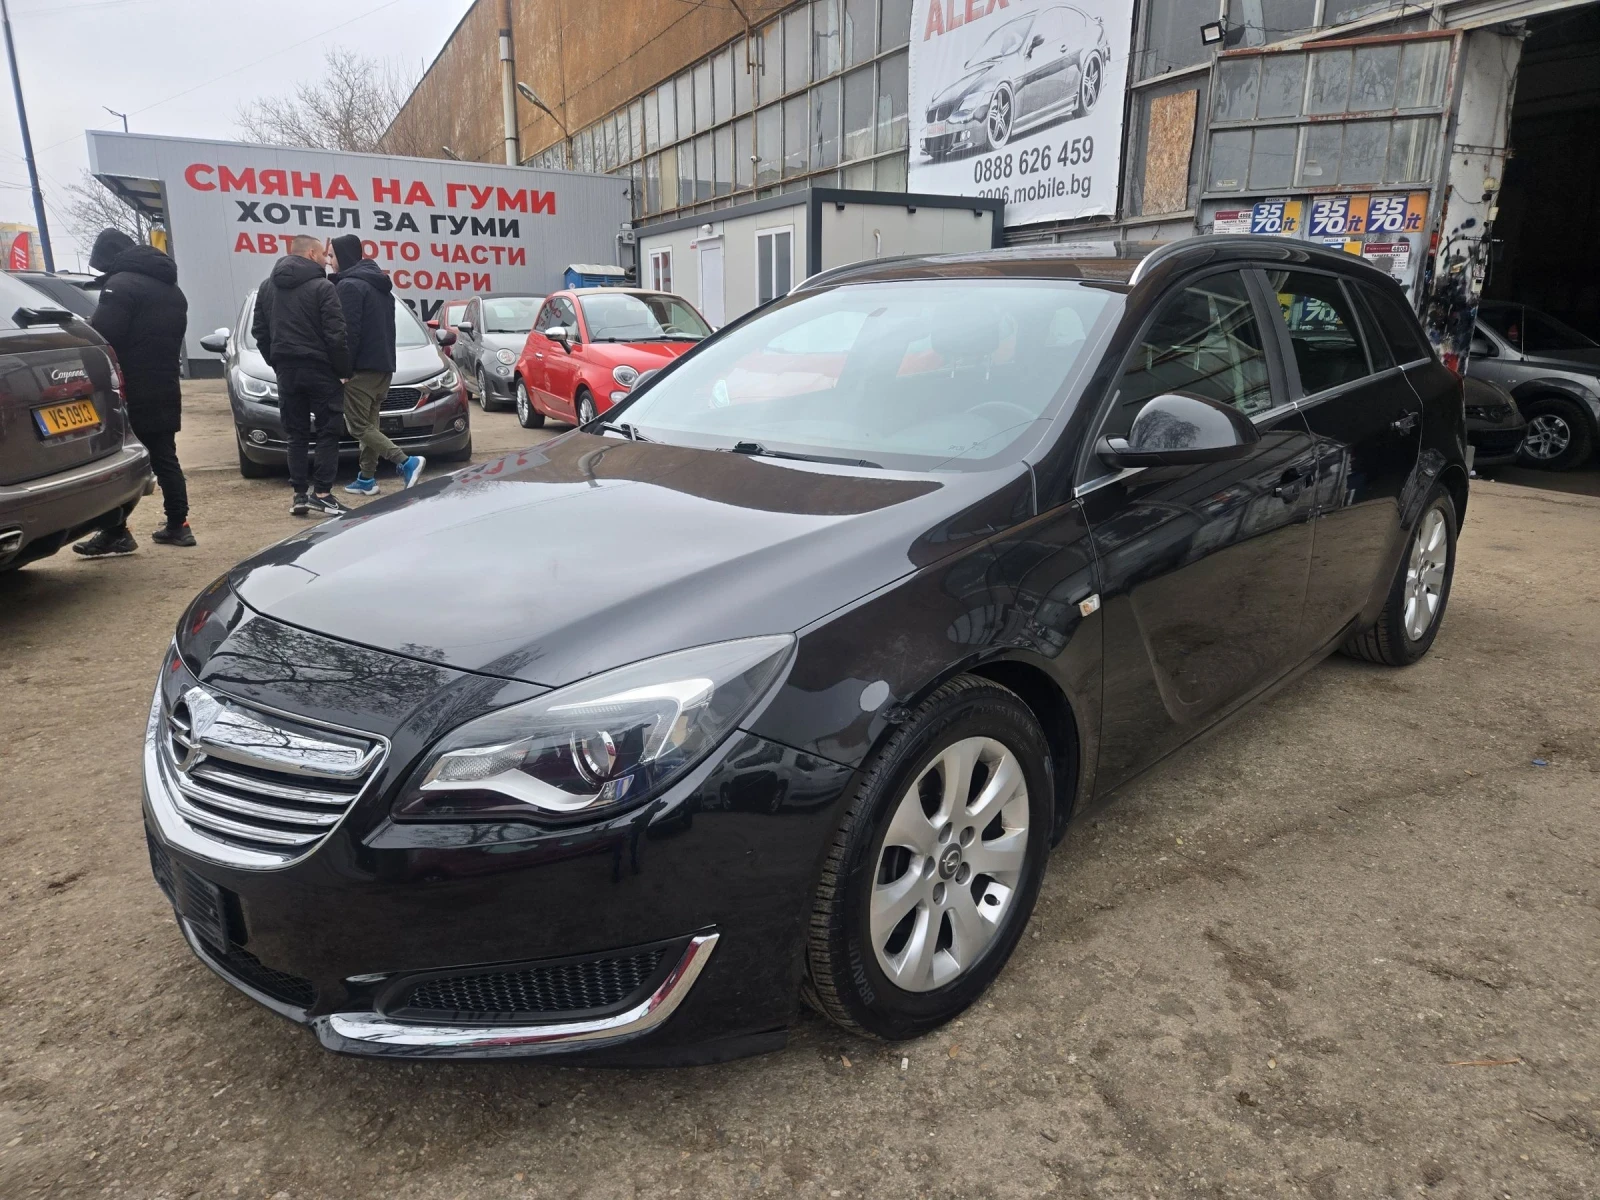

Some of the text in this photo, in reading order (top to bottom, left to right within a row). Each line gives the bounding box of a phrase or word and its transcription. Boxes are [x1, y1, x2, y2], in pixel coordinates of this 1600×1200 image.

[974, 135, 1094, 184] 0888 626 459
[185, 164, 556, 215] СМЯНА НА ГУМИ
[1256, 204, 1283, 219] 35
[1313, 200, 1348, 217] 35
[1371, 197, 1406, 214] 35
[236, 200, 520, 239] ХОТЕЛ ЗА ГУМИ
[431, 243, 526, 265] ЧАСТИ
[382, 269, 491, 291] СОАРИ
[48, 408, 68, 430] VS
